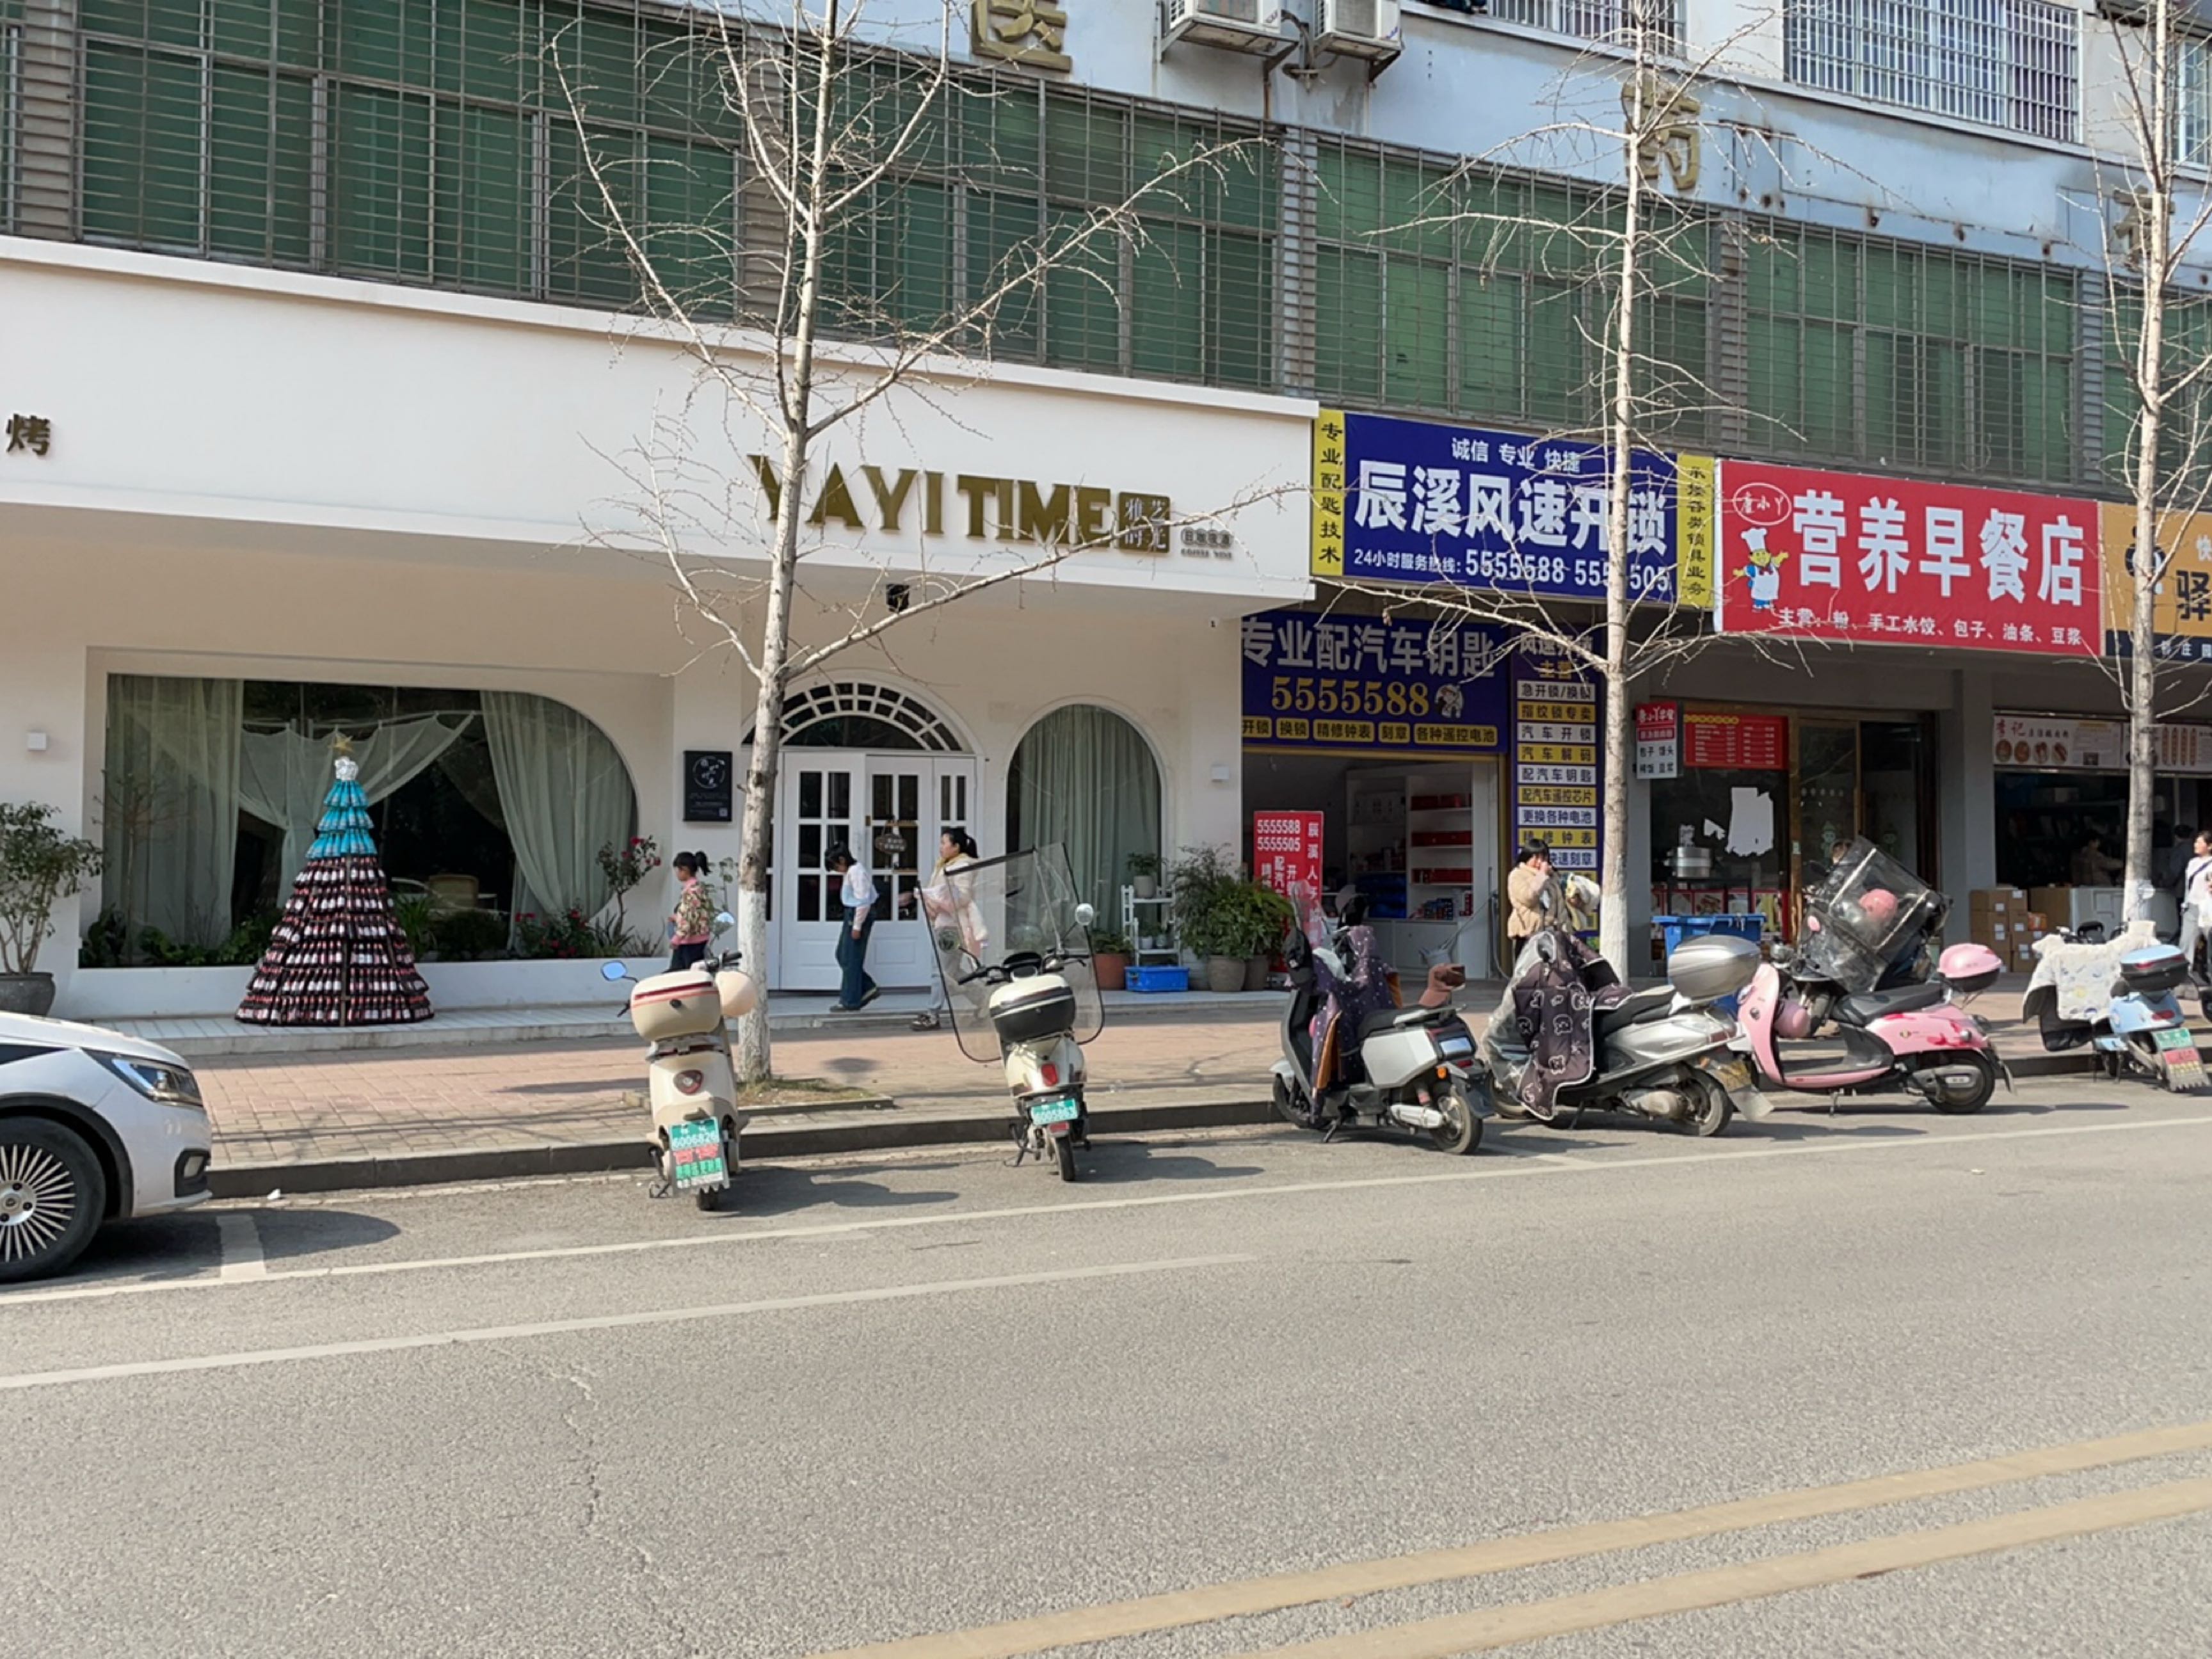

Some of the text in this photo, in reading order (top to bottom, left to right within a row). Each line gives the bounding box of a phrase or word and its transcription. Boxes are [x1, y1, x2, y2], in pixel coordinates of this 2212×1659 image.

[6, 413, 50, 456] 烤
[1452, 437, 1581, 473] 诚信 专业 快捷
[1318, 421, 1343, 565] 专业配匙技术
[1353, 460, 1668, 556] 辰溪风速开锁
[1792, 488, 2085, 606] 营养早餐店
[1465, 549, 1564, 584] 5555588
[2177, 570, 2212, 621] 驿
[1242, 618, 1495, 678] 专业配汽车钥匙
[1272, 676, 1429, 716] 5555588
[1522, 705, 1591, 719] 指纹锁专卖
[1242, 719, 1270, 735] 开锁
[1280, 721, 1307, 737] 换锁
[1416, 727, 1496, 743] 各种遥控电池
[1522, 725, 1591, 741] 汽车开锁
[1522, 768, 1591, 782] 配汽车钥匙
[1522, 788, 1591, 803] 配汽车遥控芯片
[1257, 819, 1300, 834] 5555588
[1523, 810, 1592, 824] 更换各种电池
[1257, 837, 1300, 852] 5555505
